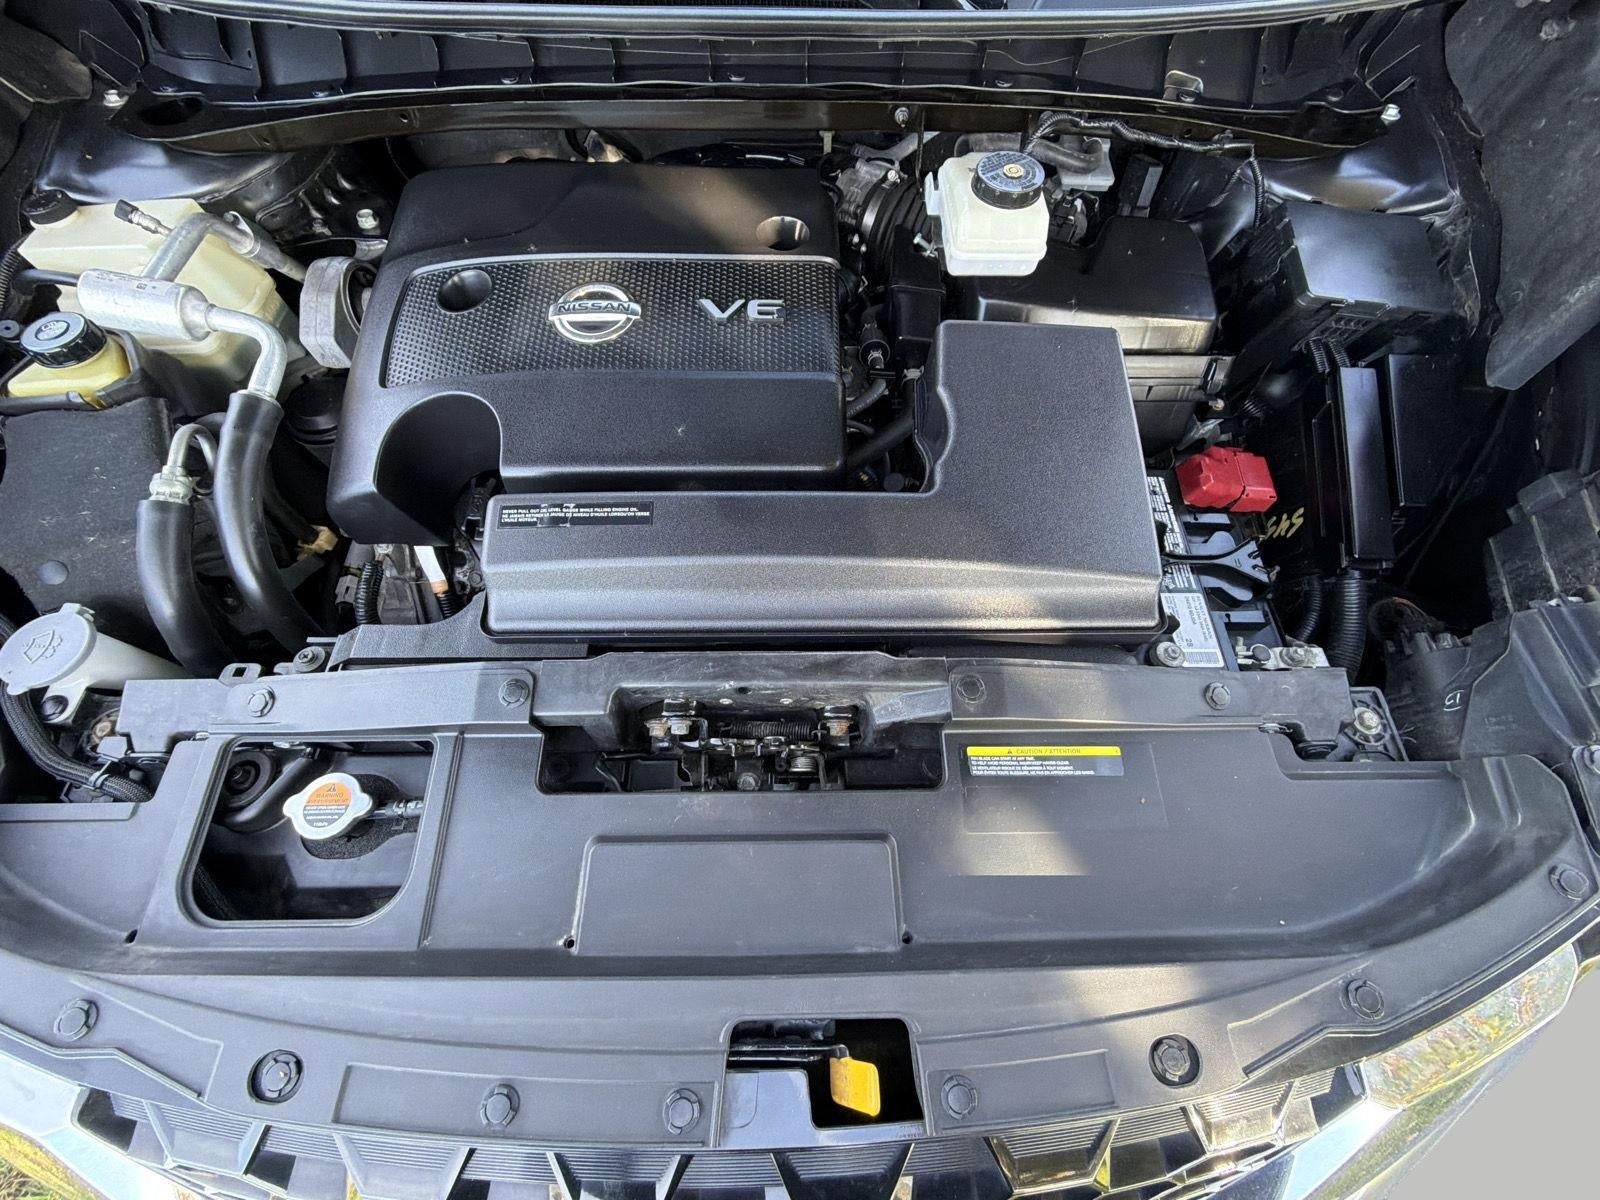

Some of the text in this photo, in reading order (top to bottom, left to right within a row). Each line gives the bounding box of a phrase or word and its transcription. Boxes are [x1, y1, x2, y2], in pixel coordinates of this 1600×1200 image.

[557, 301, 631, 313] NISSAN
[699, 298, 787, 323] V6
[1185, 638, 1194, 648] 28
